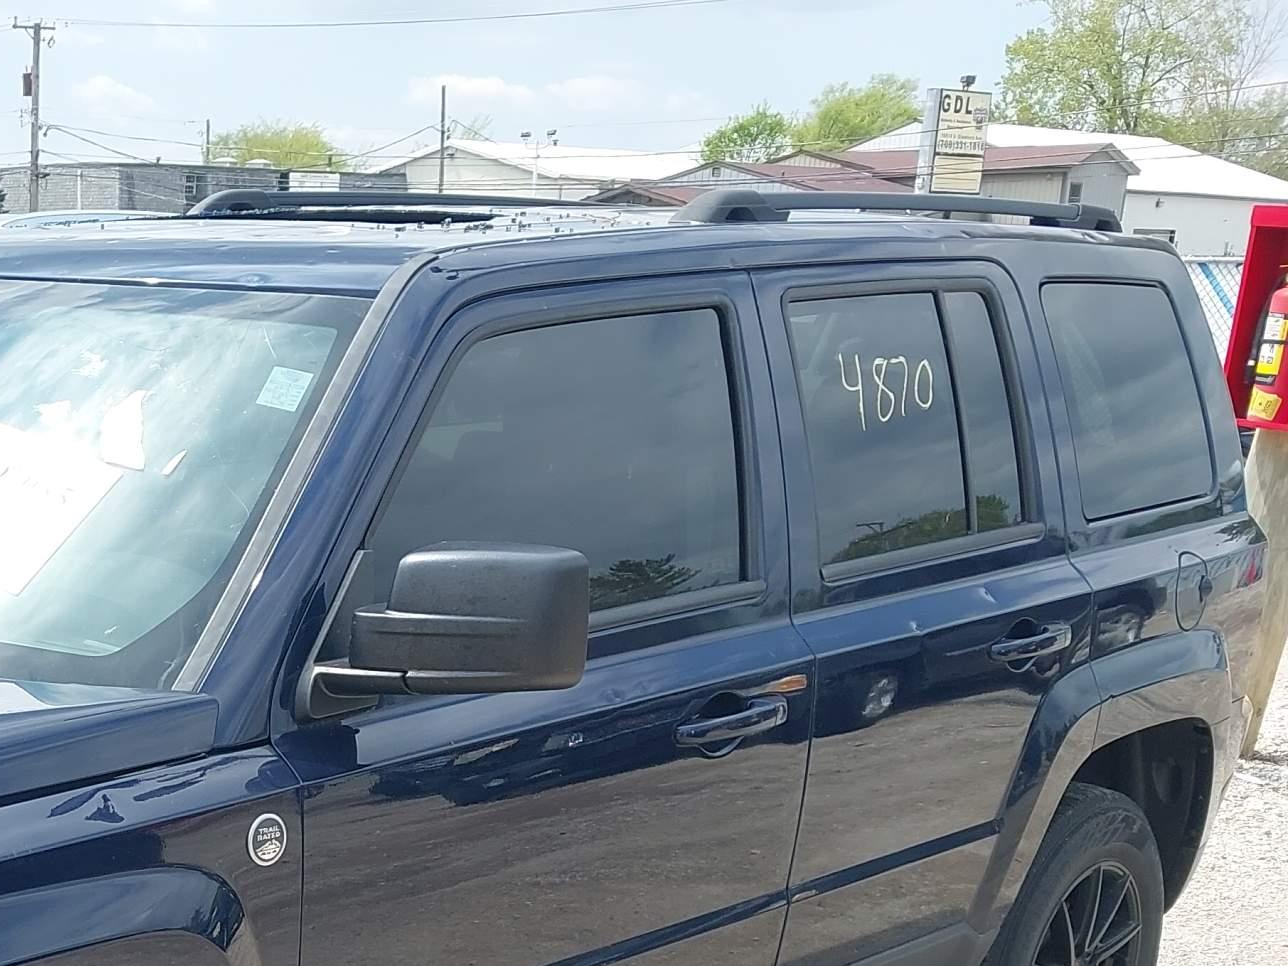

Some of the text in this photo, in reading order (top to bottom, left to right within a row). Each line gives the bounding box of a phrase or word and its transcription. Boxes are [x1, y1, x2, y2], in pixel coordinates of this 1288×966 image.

[942, 94, 973, 115] GDL
[837, 351, 934, 432] 4870
[257, 824, 281, 835] TRAIL
[257, 831, 281, 842] RATED
